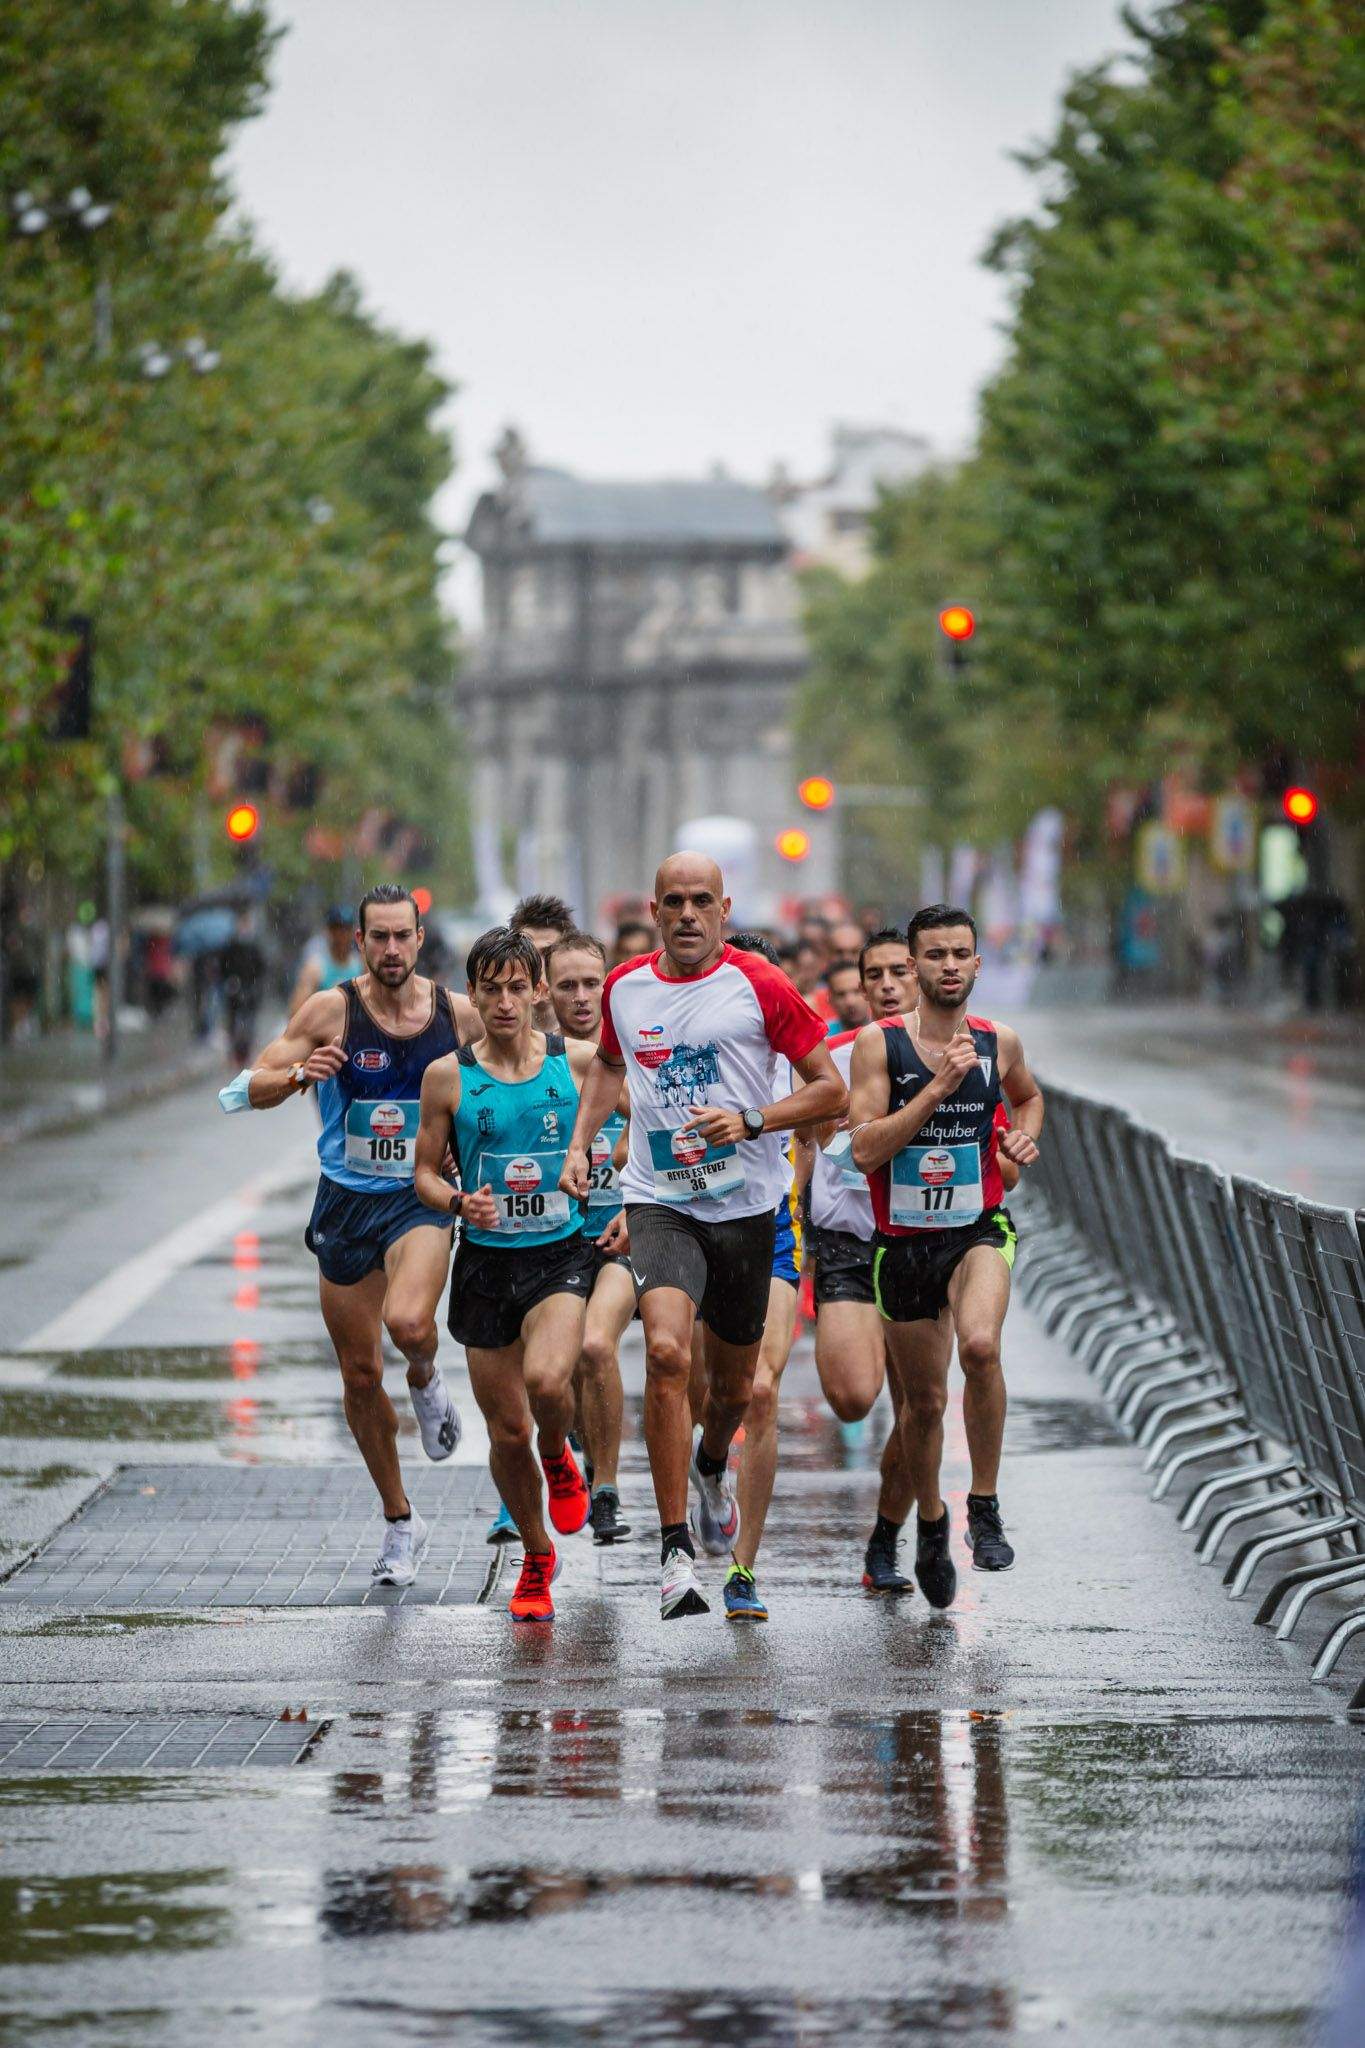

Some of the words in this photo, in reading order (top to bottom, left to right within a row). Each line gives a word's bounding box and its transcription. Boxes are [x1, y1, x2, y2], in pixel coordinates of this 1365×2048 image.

[920, 1120, 977, 1144] alquiber
[367, 1138, 407, 1161] 105
[589, 1167, 613, 1190] 52
[667, 1169, 691, 1182] REYES
[693, 1160, 727, 1178] ESTÉVEZ
[690, 1177, 707, 1192] 36
[503, 1193, 545, 1218] 150
[920, 1186, 954, 1211] 177
